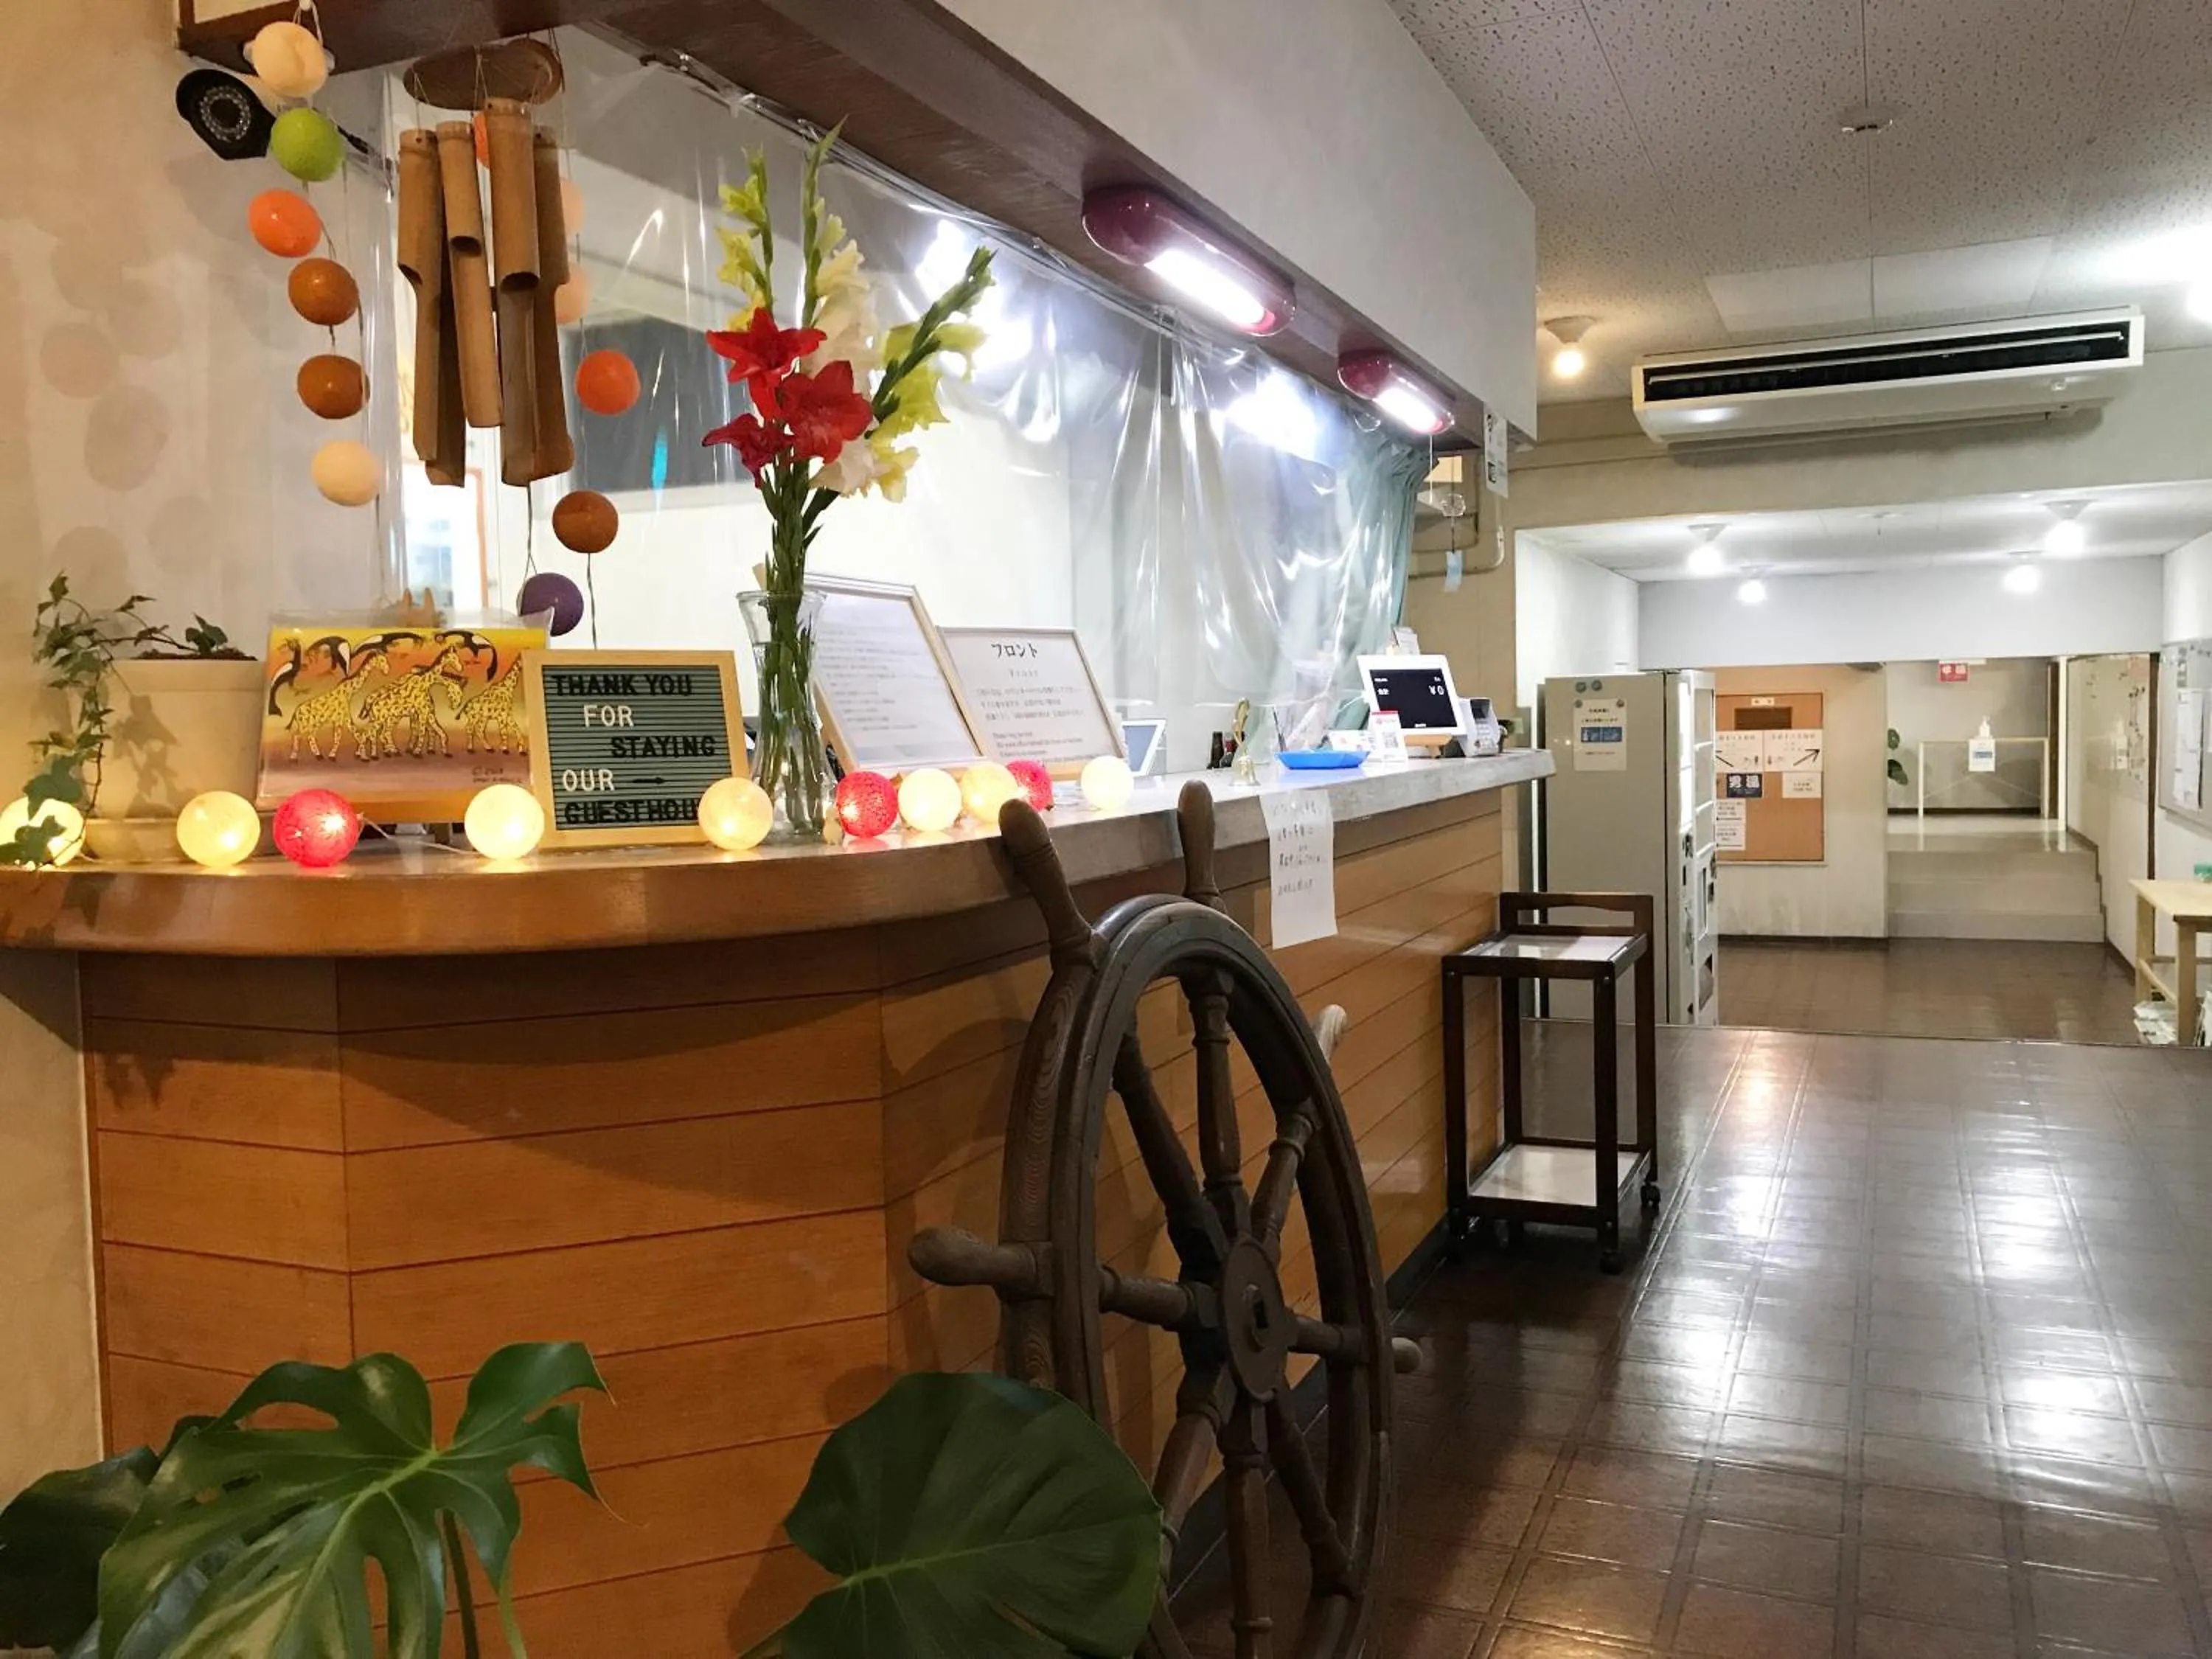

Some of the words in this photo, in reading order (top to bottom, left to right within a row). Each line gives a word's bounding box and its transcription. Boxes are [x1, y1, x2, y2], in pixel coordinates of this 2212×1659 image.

[991, 643, 1038, 658] フロント
[552, 674, 638, 696] THANK
[644, 674, 692, 696] YOU
[583, 704, 634, 727] FOR
[611, 736, 715, 758] STAYING
[563, 769, 615, 791] OUR
[566, 798, 700, 824] GUESTHOU
